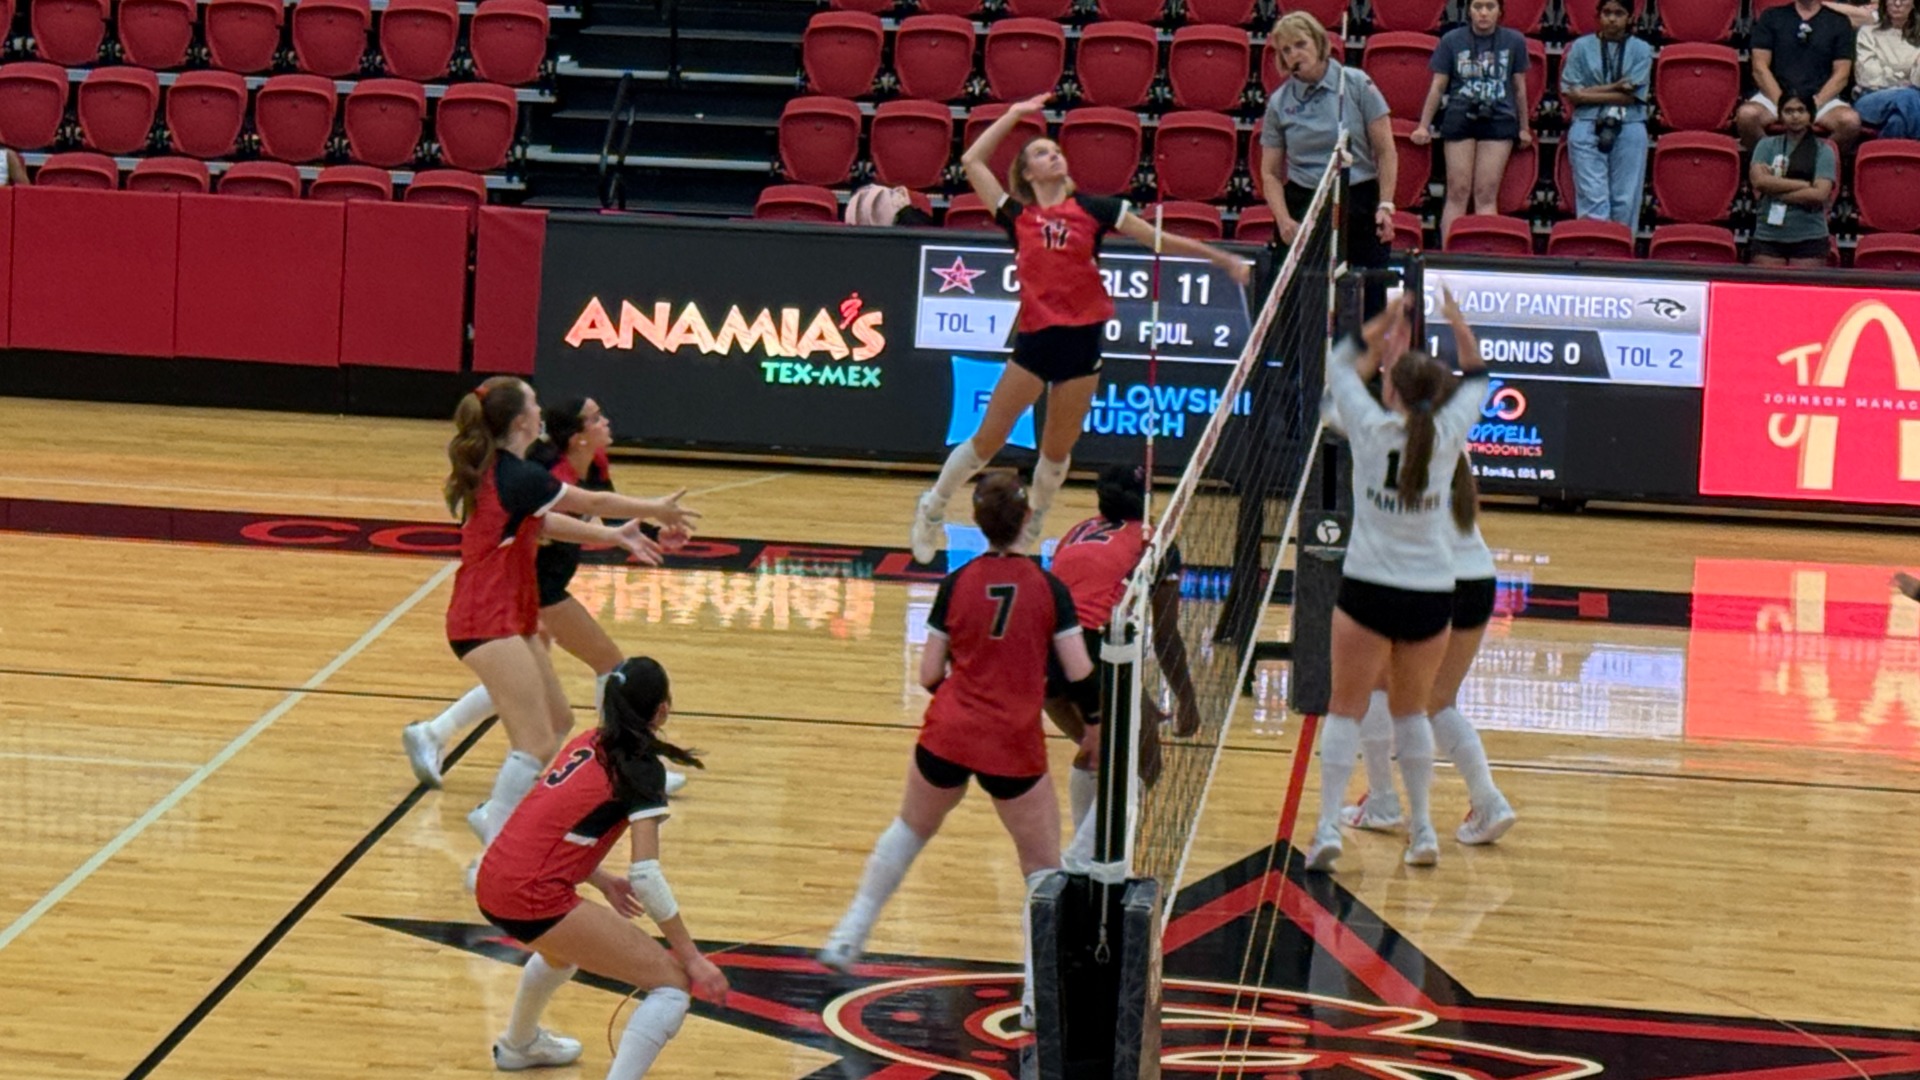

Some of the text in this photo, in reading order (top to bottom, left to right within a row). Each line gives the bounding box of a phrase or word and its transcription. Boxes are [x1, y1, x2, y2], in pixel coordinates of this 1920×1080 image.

[1003, 264, 1210, 305] CRLS 11
[1516, 292, 1633, 320] PANTHERS
[565, 292, 887, 361] ANAMIA'S
[936, 312, 996, 334] TOL 1
[1105, 319, 1230, 347] 0 FOUL 2
[1427, 335, 1580, 364] 1 BONUS 0
[1617, 345, 1683, 369] TOL 2
[761, 361, 882, 388] TEX-MEX
[1763, 393, 1847, 407] JOHNSON
[1467, 423, 1543, 444] OPPELL
[1466, 442, 1543, 456] RTHODONTICS
[986, 583, 1018, 640] 7
[544, 747, 596, 789] 3
